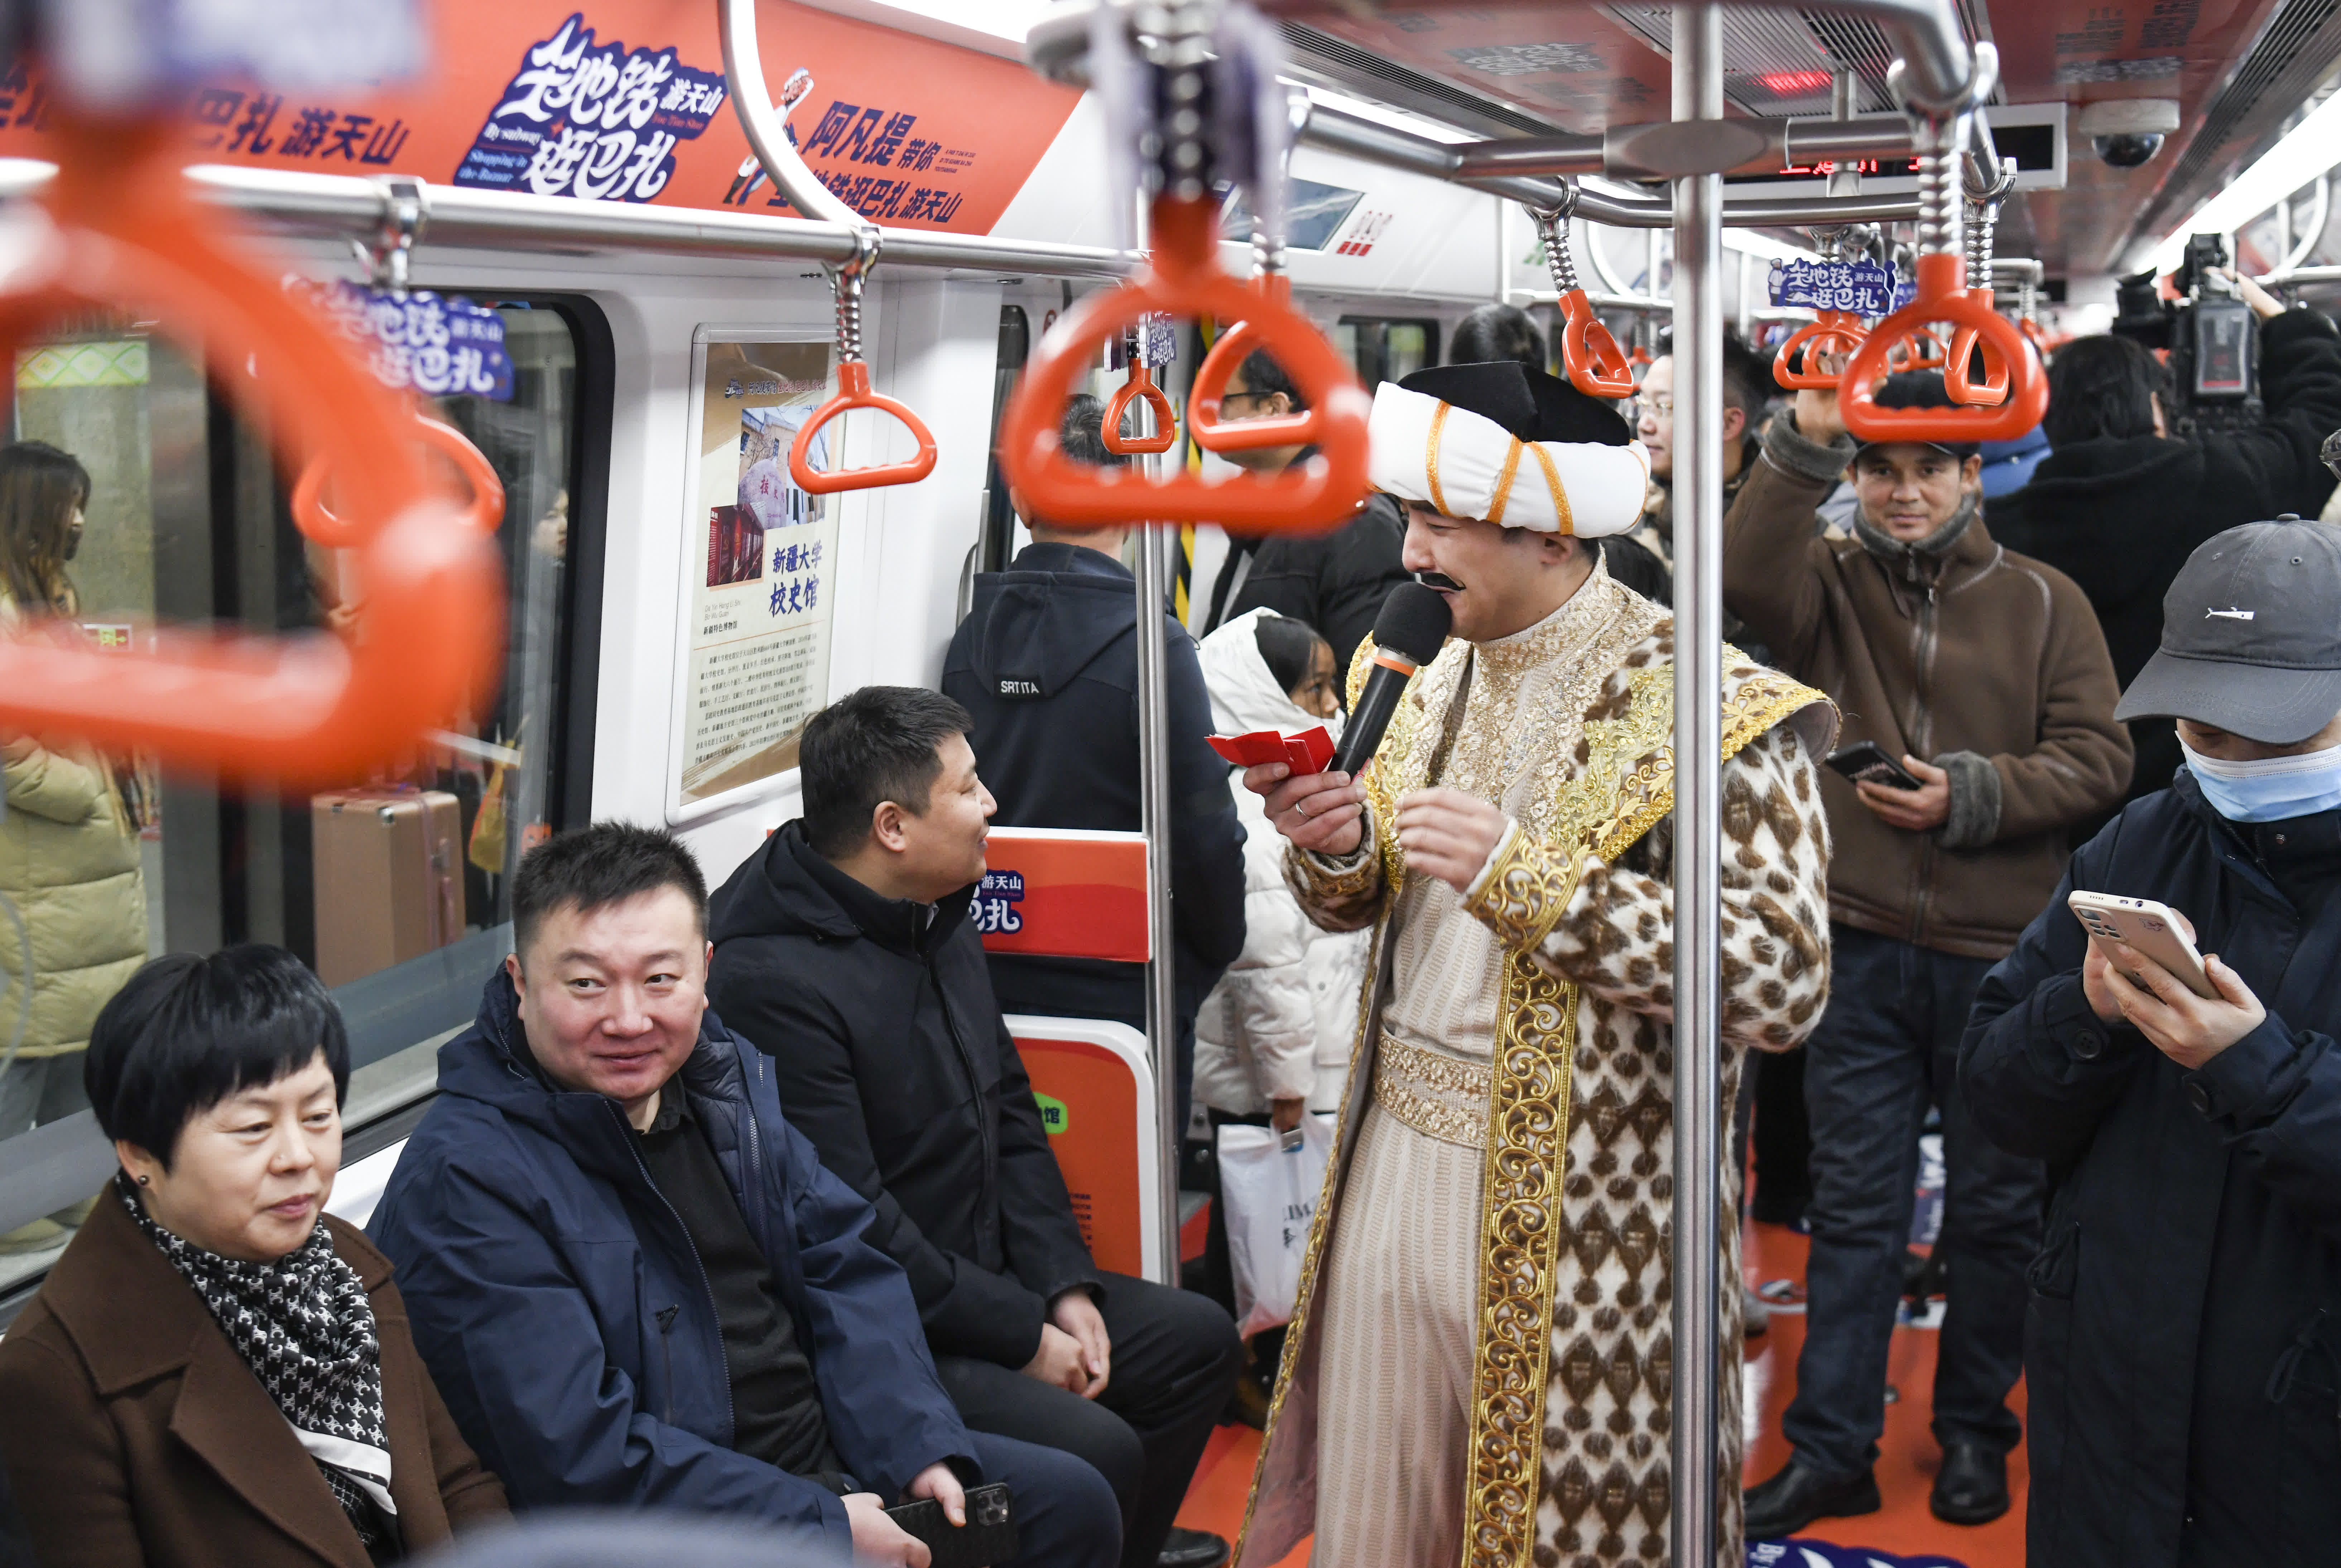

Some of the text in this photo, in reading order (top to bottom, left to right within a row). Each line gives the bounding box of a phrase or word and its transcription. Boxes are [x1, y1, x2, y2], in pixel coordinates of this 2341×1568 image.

[659, 78, 724, 116] 游天山
[280, 106, 411, 165] 游天山
[898, 187, 963, 223] 游天山
[1854, 272, 1883, 283] 游天山
[1811, 287, 1879, 310] 逛巴扎
[773, 538, 823, 575] 新疆大学
[769, 574, 819, 617] 校史馆
[703, 620, 737, 635] 新疆特色博物馆
[981, 875, 1021, 890] 游天山
